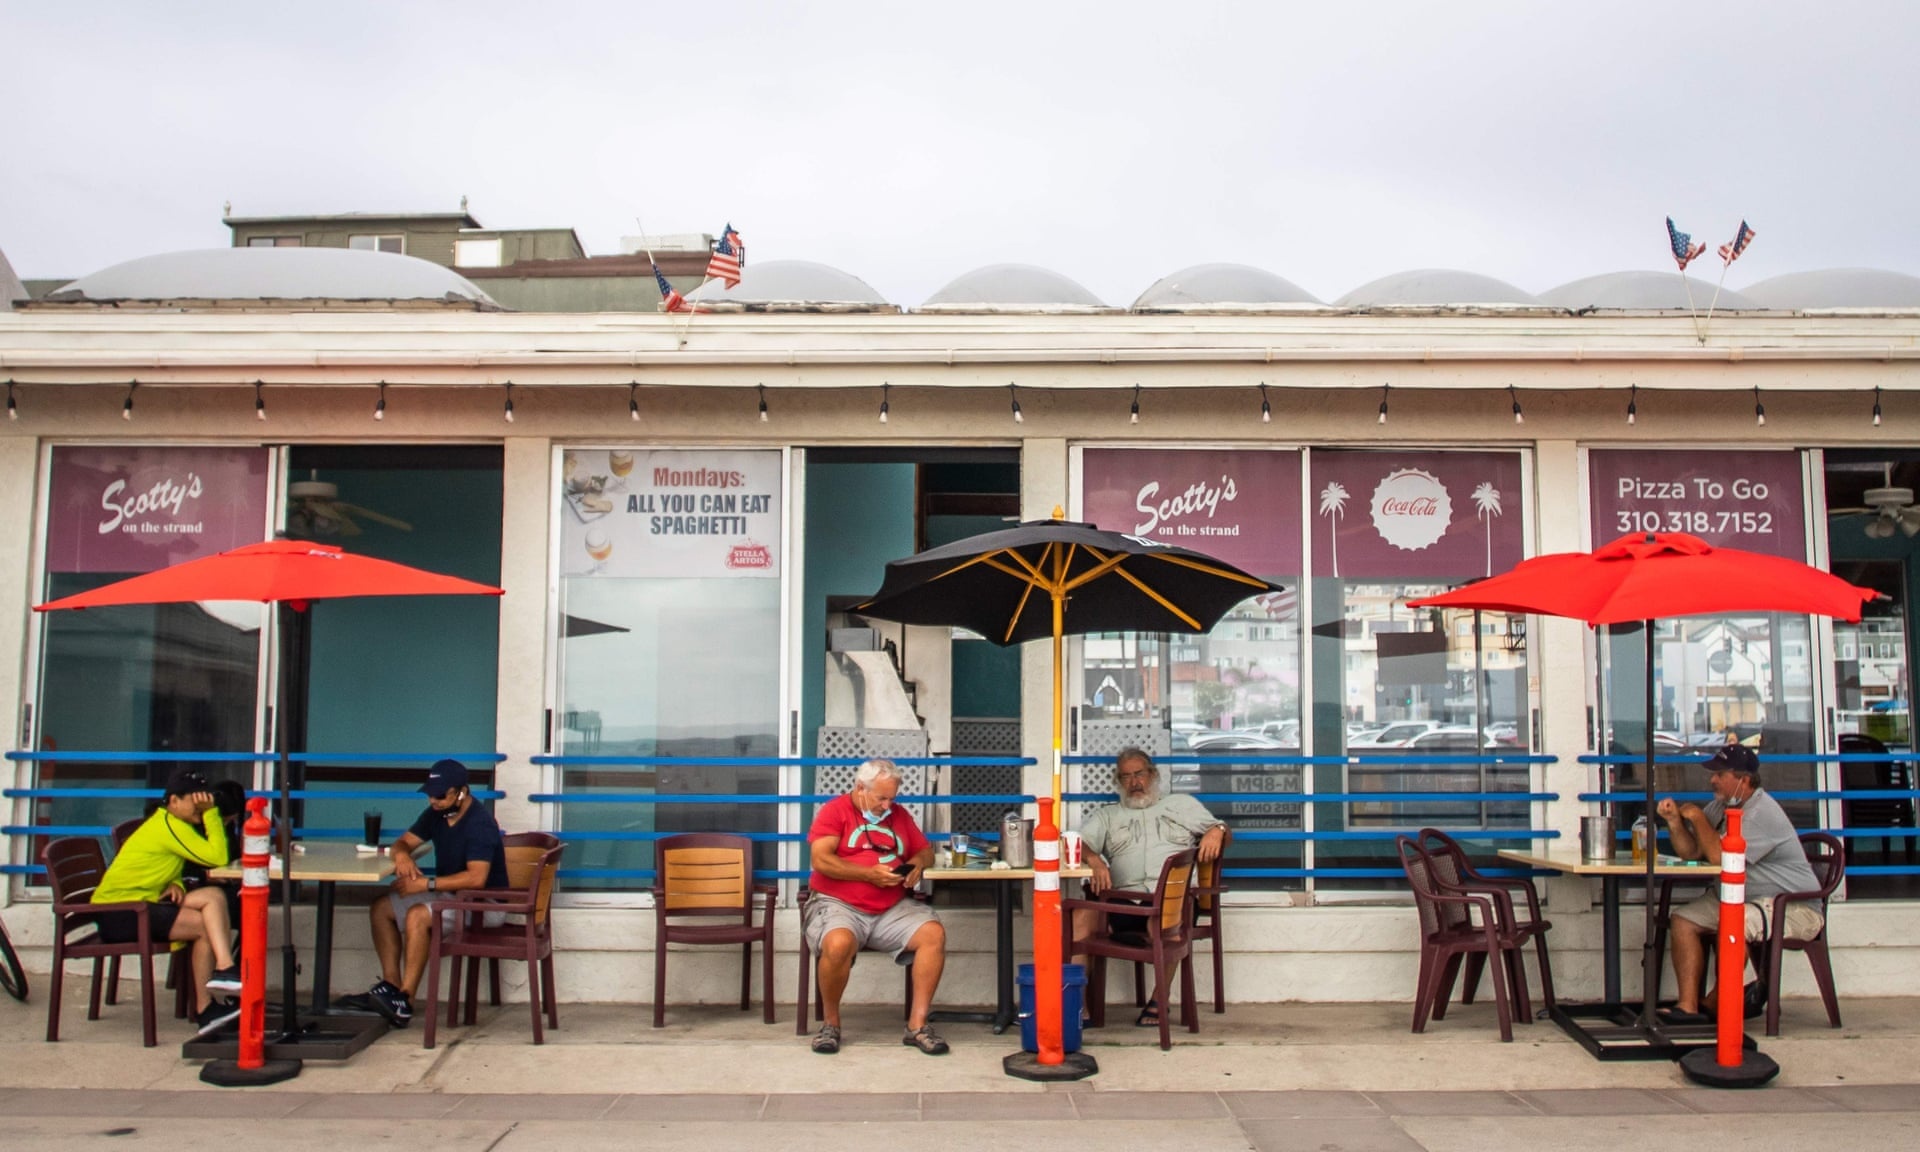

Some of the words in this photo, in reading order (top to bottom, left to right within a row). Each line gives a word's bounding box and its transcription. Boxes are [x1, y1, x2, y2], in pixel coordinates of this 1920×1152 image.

[653, 467, 746, 489] Mondays:
[1618, 477, 1686, 499] Pizza
[1694, 478, 1724, 500] To
[1732, 478, 1769, 500] Go
[99, 472, 203, 534] Scotty's
[627, 494, 656, 513] ALL
[660, 494, 695, 513] YOU
[700, 494, 737, 513] CAN
[741, 494, 771, 513] EAT
[1135, 474, 1238, 536] Scotty's
[122, 523, 137, 533] on
[141, 522, 160, 533] the
[163, 522, 203, 533] strand
[650, 516, 746, 535] SPAGHETTI
[1158, 527, 1174, 536] on
[1177, 524, 1197, 536] the
[1199, 524, 1240, 536] strand
[1616, 511, 1773, 533] 310.318.7152
[734, 550, 764, 558] STELLA
[734, 557, 765, 565] ARTOIS
